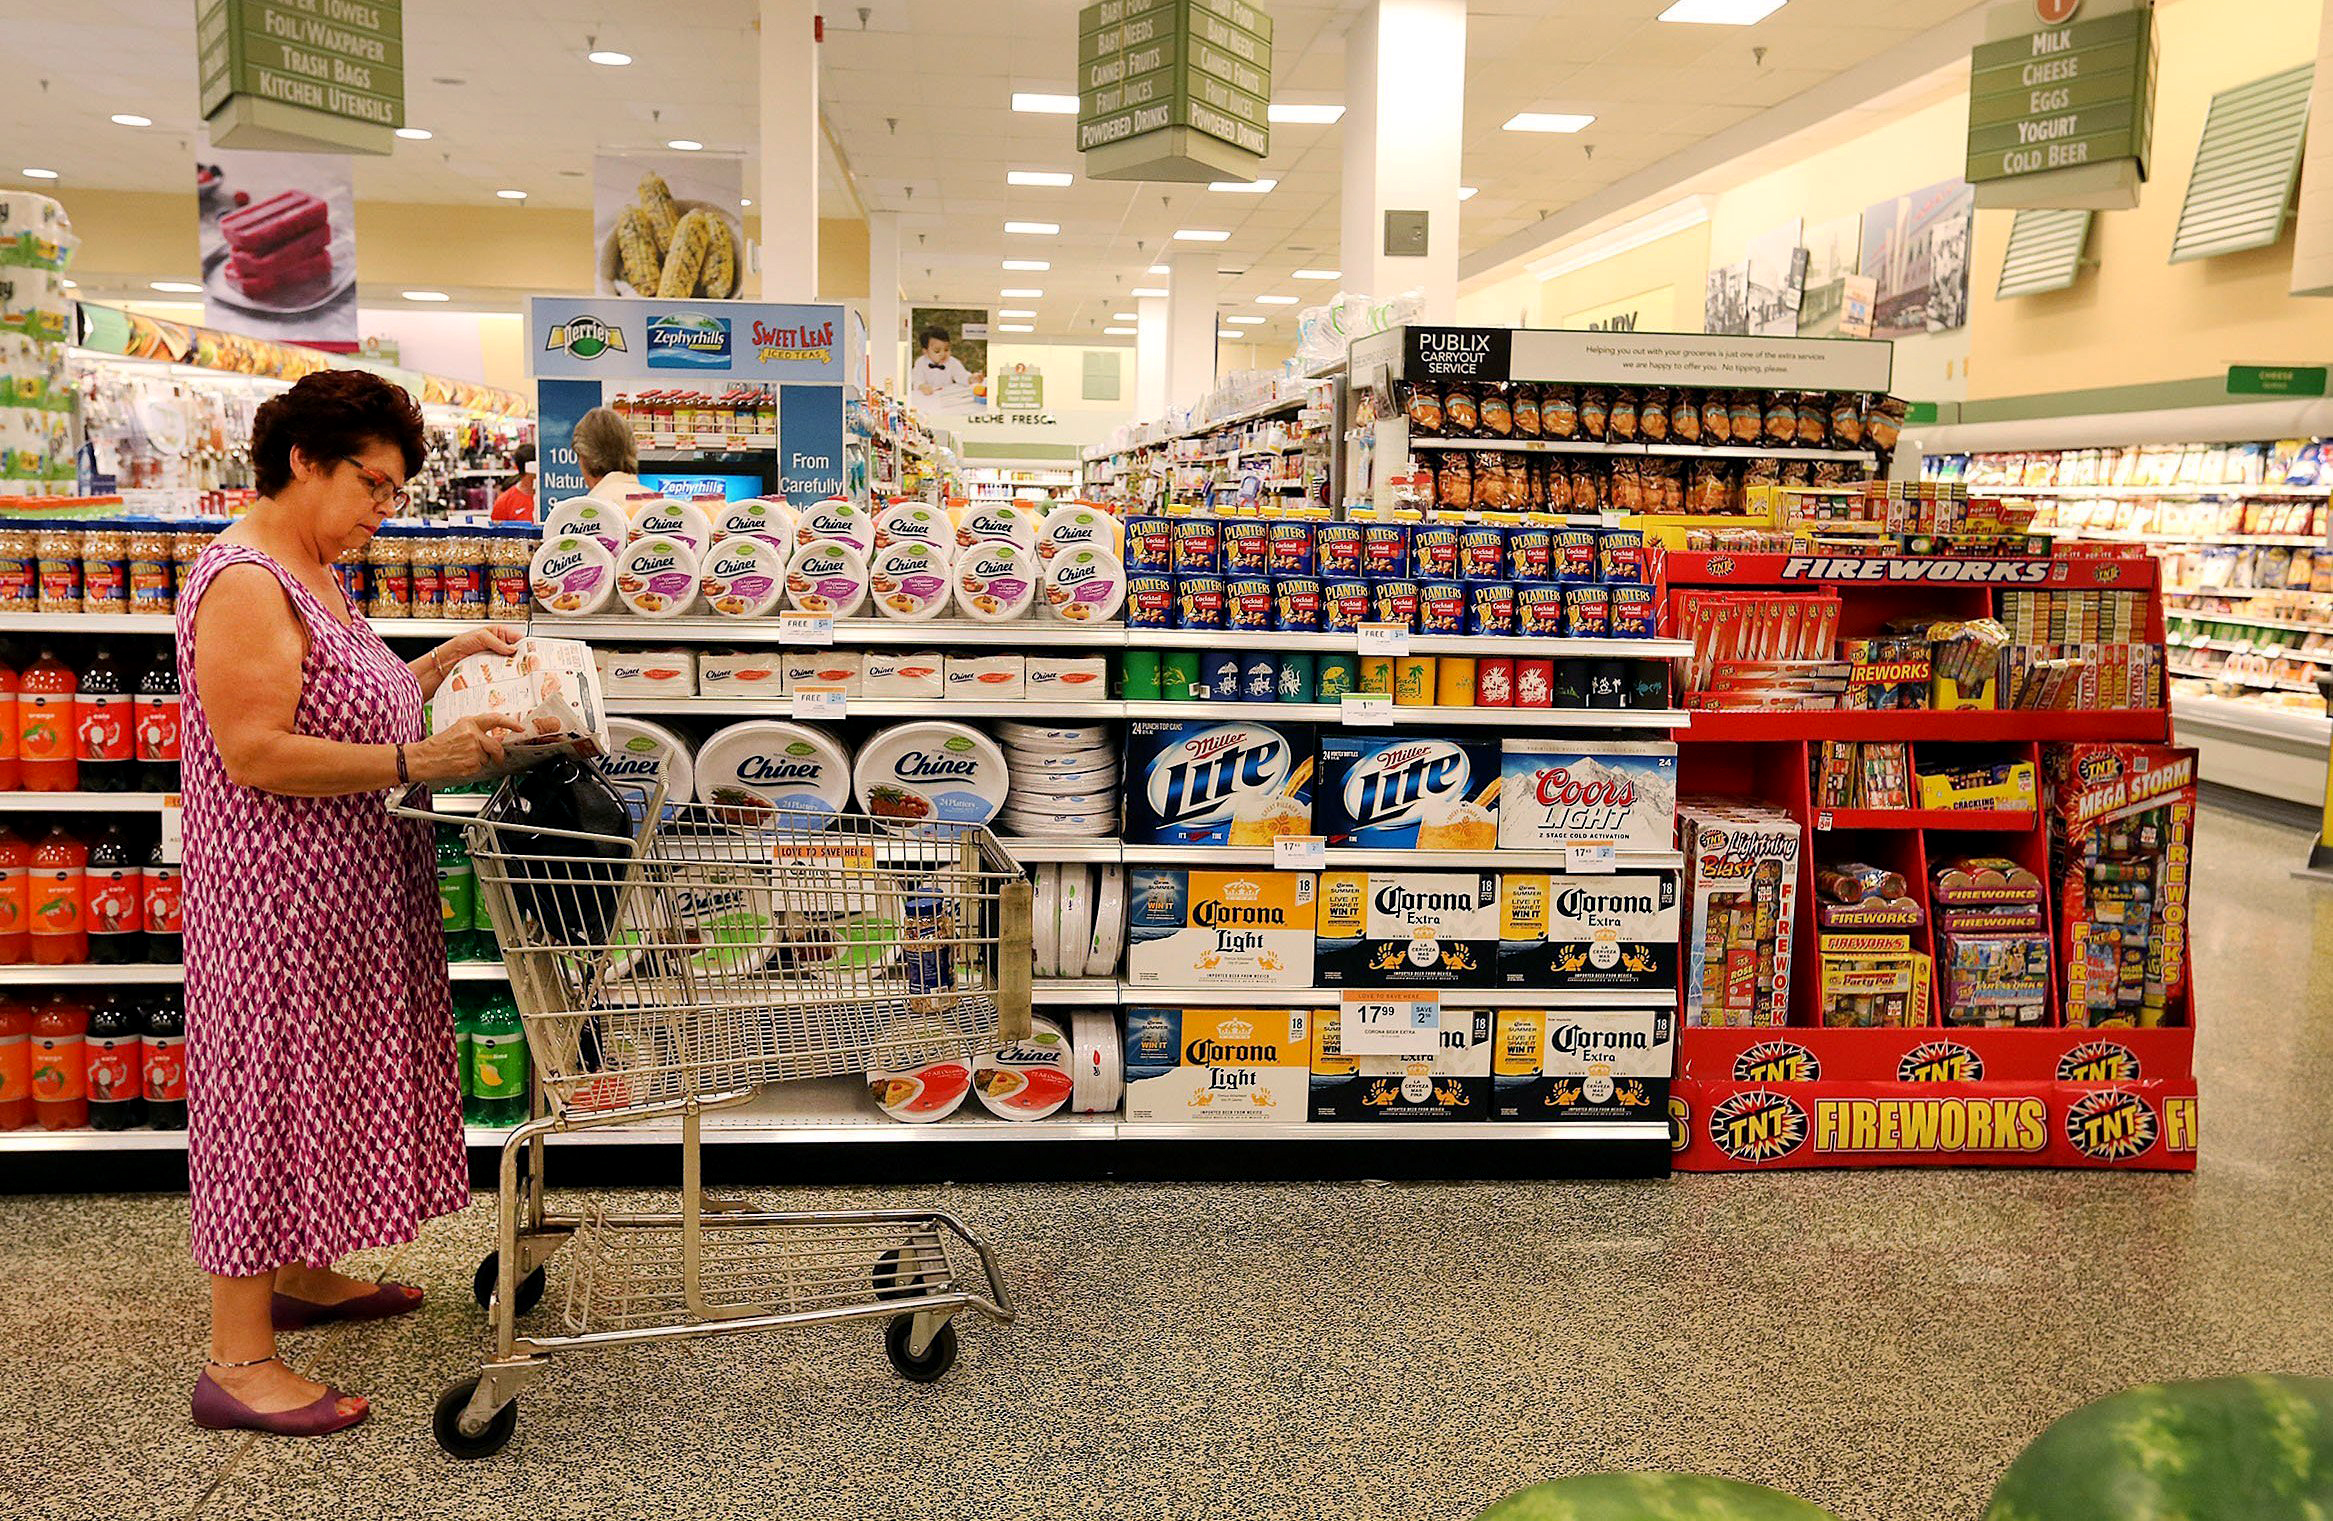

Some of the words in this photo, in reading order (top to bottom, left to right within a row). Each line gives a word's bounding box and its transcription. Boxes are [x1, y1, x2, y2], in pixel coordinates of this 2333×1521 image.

[324, 0, 379, 30] TOWELS
[265, 9, 385, 63] FOIL/WAXPAPER
[1098, 30, 1121, 55] BABY
[1124, 20, 1153, 44] NEEDS
[2031, 30, 2072, 56] MILK
[282, 46, 328, 79] TRASH
[334, 59, 370, 89] BAGS
[1091, 59, 1126, 87] CANNED
[1129, 48, 1160, 76] FRUITS
[2022, 57, 2078, 86] CHEESE
[260, 71, 323, 107] KITCHEN
[328, 88, 393, 122] UTENSILS
[2030, 88, 2070, 113] EGGS
[1082, 116, 1131, 147] POWDERED
[1134, 105, 1168, 132] DRINKS
[1191, 103, 1235, 141] POWDERED
[1237, 122, 1264, 150] DRINKS
[2018, 115, 2078, 144] YOGURT
[2003, 150, 2041, 174] COLD
[2049, 141, 2088, 167] BEER
[564, 320, 611, 356] perrier
[653, 329, 725, 346] Zephyrhills
[752, 320, 797, 349] SWEET
[800, 321, 834, 348] LEAF
[1419, 333, 1490, 351] PUBLIX
[767, 350, 792, 360] ICED
[795, 350, 821, 360] TEAS
[1421, 352, 1486, 363] CARRYOUT
[1586, 345, 1615, 356] Helping
[1617, 347, 1631, 356] you
[1633, 347, 1645, 355] out
[1647, 347, 1663, 355] with
[1665, 349, 1681, 357] your
[1683, 350, 1717, 359] groceries
[1725, 350, 1738, 359] just
[1755, 351, 1763, 359] of
[1764, 351, 1777, 359] the
[1429, 363, 1477, 374] SERVICE
[1649, 362, 1671, 371] happy
[968, 415, 1004, 423] LECHE
[792, 453, 830, 469] From
[660, 479, 724, 495] Zephyrhills
[780, 476, 843, 495] Carefully
[642, 516, 683, 530] Chinet
[725, 516, 766, 530] Chinet
[812, 515, 852, 530] Chinet
[889, 518, 929, 534] Chinet
[972, 517, 1013, 533] Chinet
[1173, 522, 1215, 537] PLANTERS
[1053, 526, 1093, 539] Chinet
[1317, 524, 1360, 542] PLANTERS
[1459, 532, 1501, 547] PLANTERS
[1552, 532, 1594, 547] PLANTERS
[1331, 543, 1353, 551] Cocktail
[542, 553, 582, 575] Chinet
[1712, 561, 1730, 572] TNT
[1782, 557, 2050, 582] FIREWORKS
[2099, 568, 2117, 578] TNT
[1132, 722, 1142, 735] 24
[1185, 732, 1247, 758] Miller
[1323, 751, 1330, 760] 24
[1377, 746, 1431, 768] Miller
[1658, 759, 1672, 767] 24
[2088, 759, 2114, 775] TNT
[1156, 740, 1280, 829] Lite
[1351, 752, 1461, 832] Lite
[1536, 767, 1637, 807] Coors
[2079, 782, 2126, 822] MEGA
[2131, 757, 2192, 802] STORM
[1954, 797, 1995, 810] CRACKLING
[1538, 807, 1631, 830] LIGHT
[1707, 836, 1722, 845] TNT
[1727, 831, 1798, 861] Lightning
[782, 848, 801, 856] LOVE
[807, 848, 816, 856] TO
[821, 848, 840, 856] SAVE
[1700, 855, 1756, 879] Blast
[1299, 880, 1310, 891] 18
[1481, 880, 1492, 891] 18
[1662, 883, 1672, 894] 18
[1374, 885, 1473, 918] Corona
[1948, 890, 2037, 899] FIREWORKS
[1330, 908, 1347, 916] WIN
[1556, 888, 1653, 920] Corona
[1193, 899, 1285, 930] Corona
[1407, 912, 1440, 924] Extra
[1588, 914, 1621, 926] Extra
[1831, 913, 1917, 924] FIREWORKS
[1952, 918, 2036, 927] FIREWORKS
[1215, 930, 1263, 952] Light
[1828, 938, 1904, 949] FIREWORKS
[1731, 965, 1753, 980] ROSE
[1843, 977, 1874, 987] Party
[1876, 977, 1894, 985] Pak
[1292, 1018, 1302, 1029] 18
[1475, 1018, 1486, 1030] 18
[1656, 1019, 1667, 1030] 18
[1551, 1024, 1647, 1056] Corona
[1186, 1039, 1277, 1068] Corona
[1583, 1049, 1616, 1062] Extra
[1209, 1068, 1256, 1090] Light
[1729, 1106, 1787, 1150] TNT
[1817, 1100, 2044, 1149] FIREWORKS
